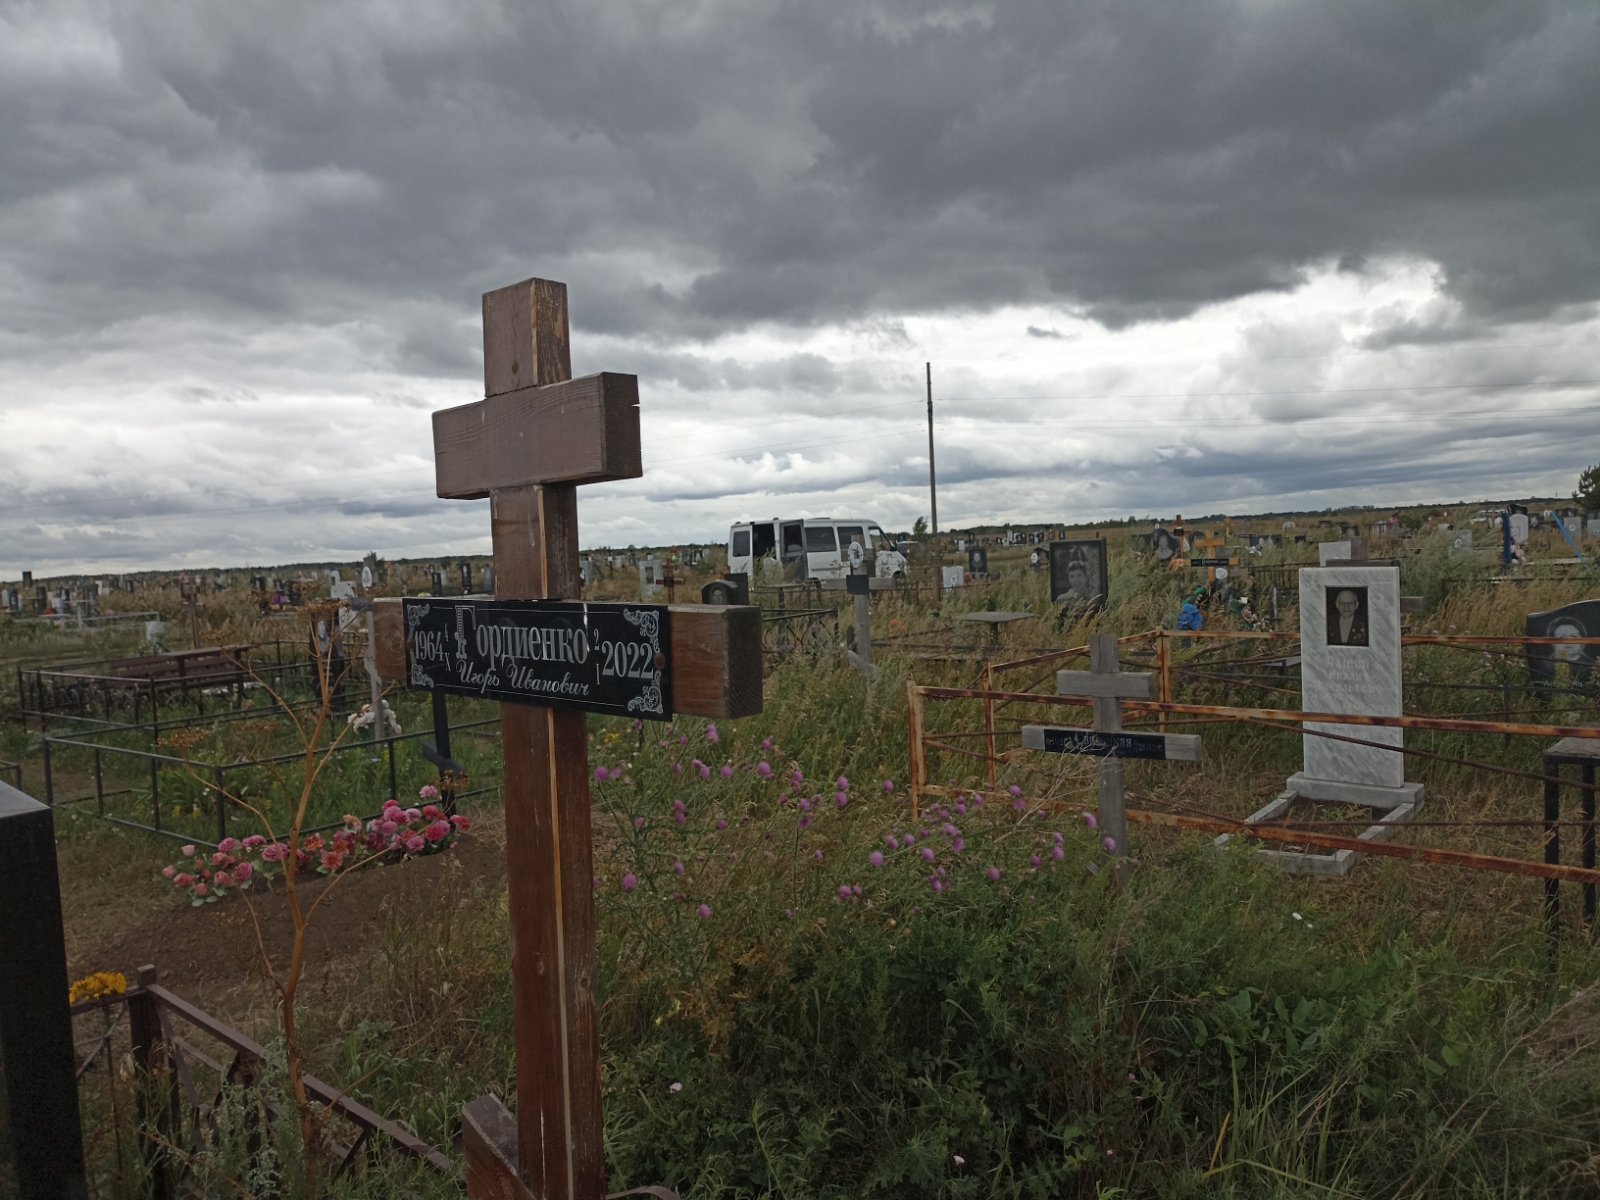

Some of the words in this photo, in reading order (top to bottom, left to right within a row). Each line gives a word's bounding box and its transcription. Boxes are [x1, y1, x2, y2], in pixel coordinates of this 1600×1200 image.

[415, 630, 444, 661] 1964
[454, 605, 588, 671] Гордиенко
[593, 628, 600, 651] 2
[455, 659, 500, 694] Игорь
[505, 664, 590, 695] Иванович
[602, 640, 654, 679] 2022
